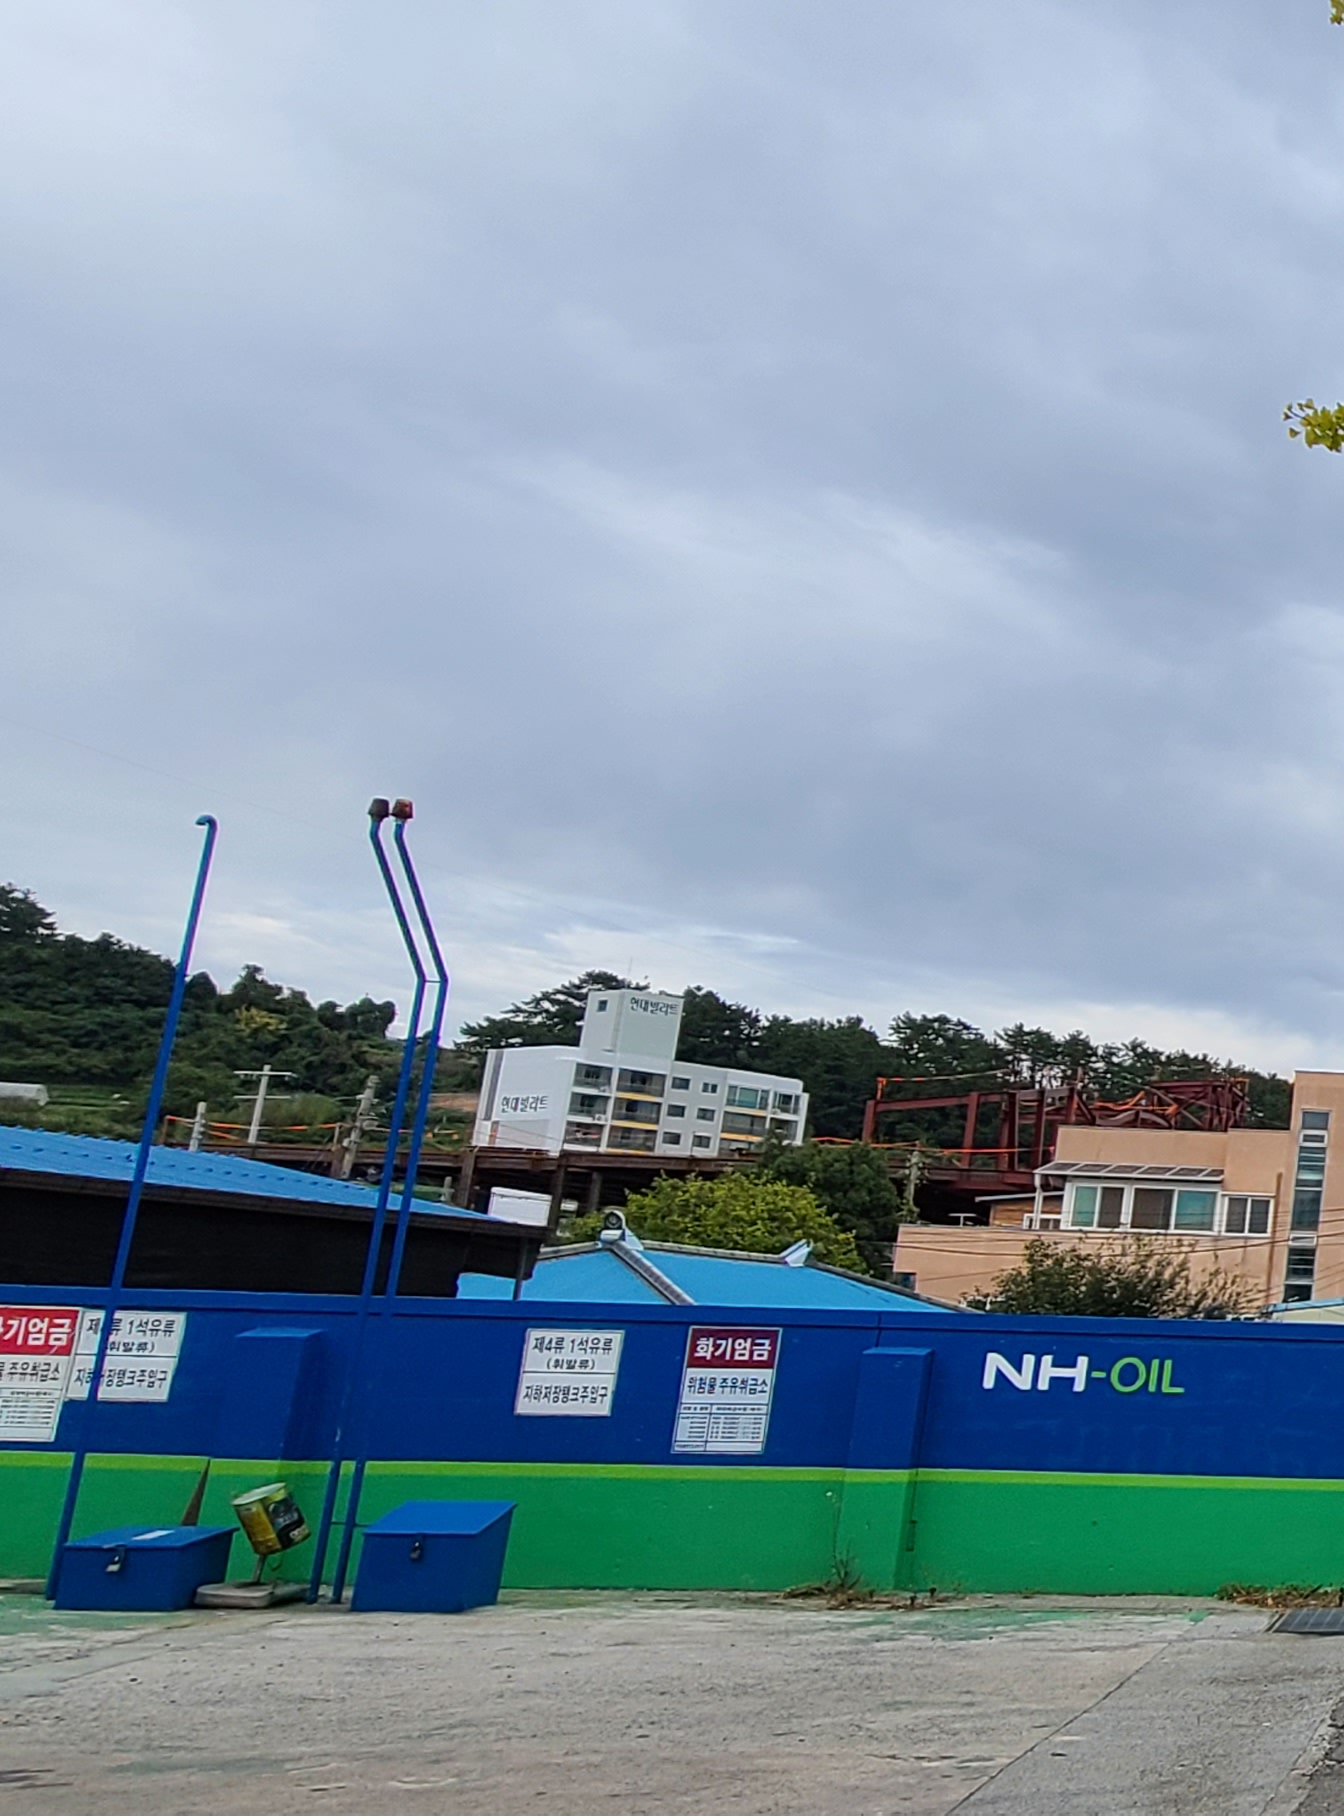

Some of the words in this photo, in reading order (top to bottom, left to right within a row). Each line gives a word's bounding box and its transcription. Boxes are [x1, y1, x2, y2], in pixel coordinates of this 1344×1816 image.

[87, 1318, 122, 1337] 제류
[128, 1318, 175, 1338] 1석유류
[532, 1336, 565, 1354] 제4류
[570, 1337, 613, 1355] 1석유류
[694, 1337, 771, 1360] 화기엄금
[982, 1352, 1185, 1393] NH-OIL
[687, 1377, 717, 1394] 위험물
[718, 1377, 768, 1395] 주유취급소
